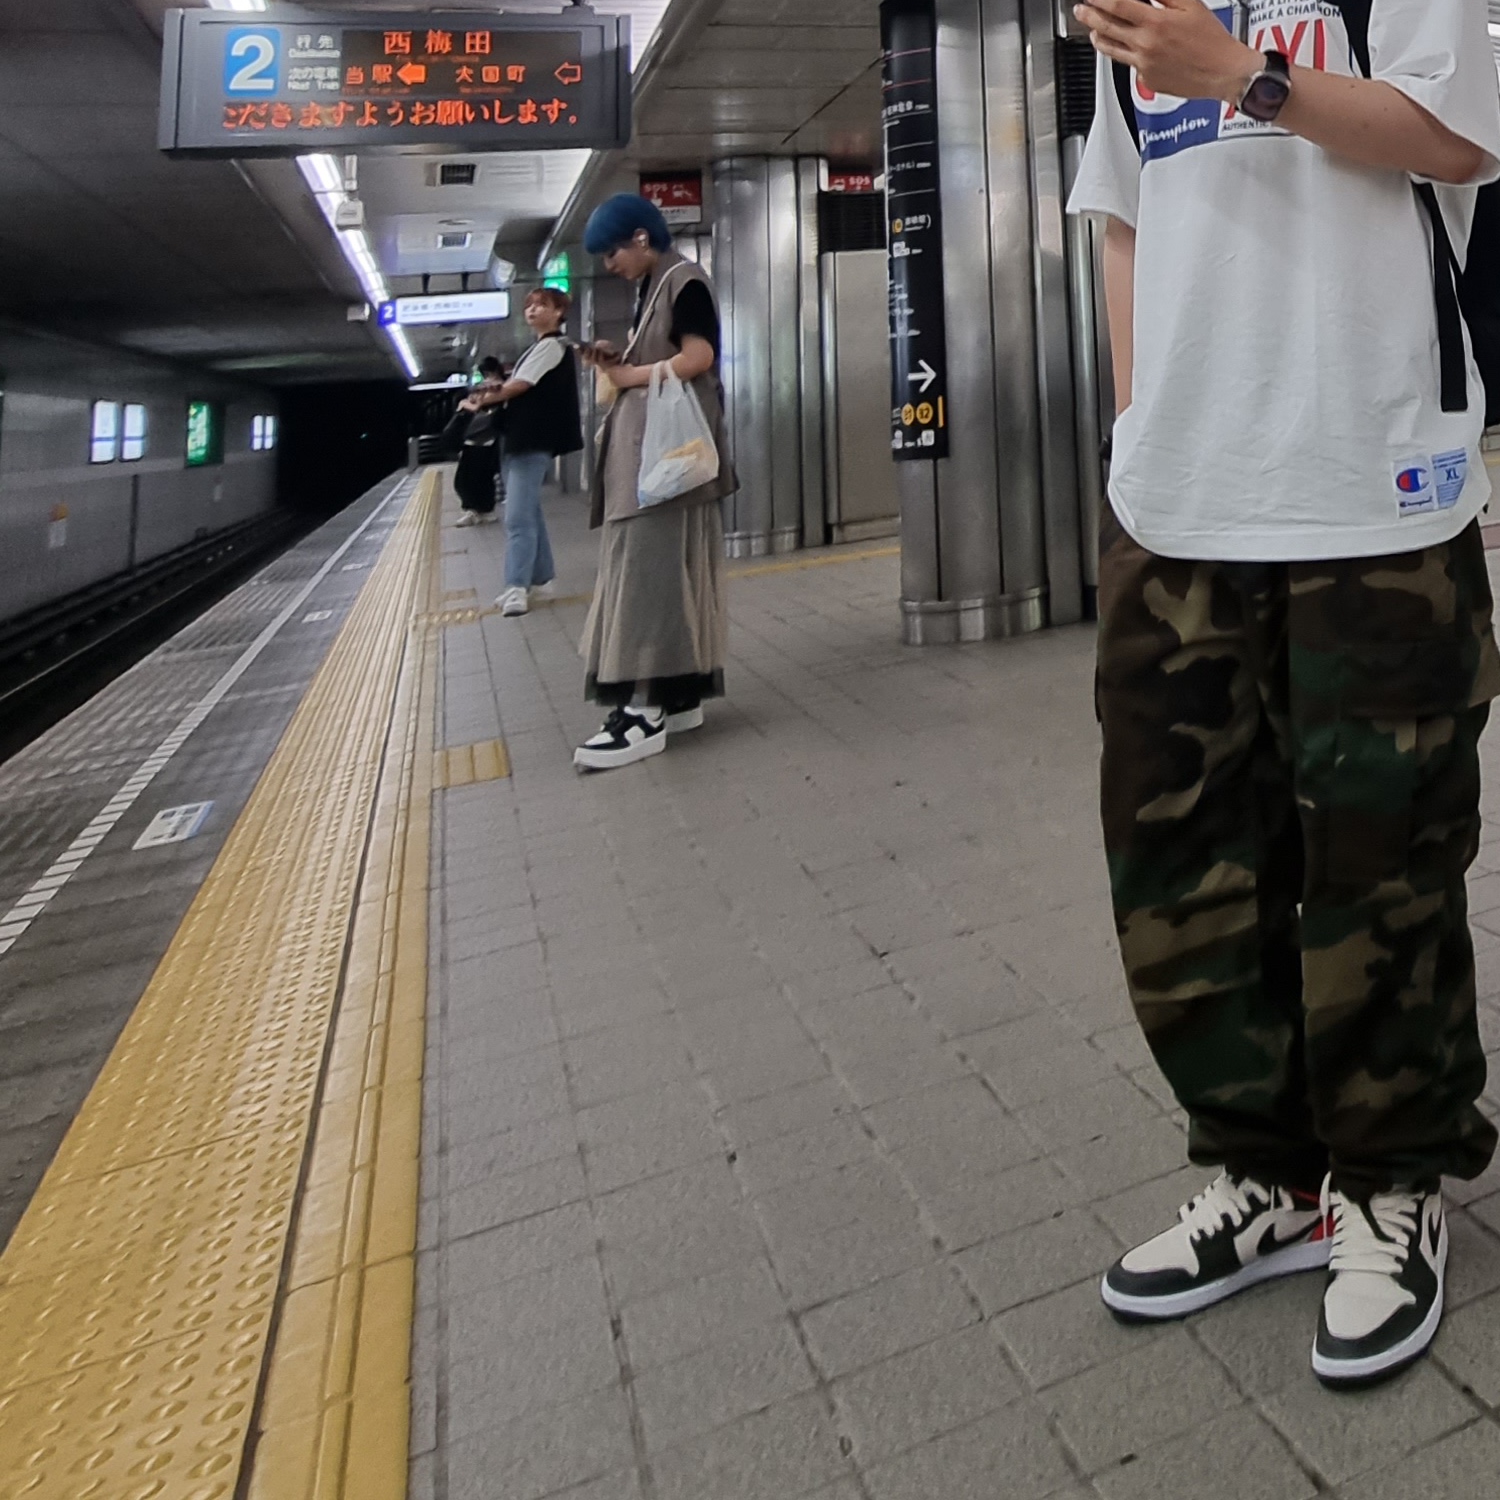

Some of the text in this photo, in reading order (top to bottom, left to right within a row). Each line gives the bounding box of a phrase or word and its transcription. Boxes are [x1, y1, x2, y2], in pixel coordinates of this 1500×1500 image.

[383, 29, 491, 55] 西梅田
[229, 34, 275, 90] 2
[384, 304, 394, 319] 2
[1445, 467, 1460, 481] XL
